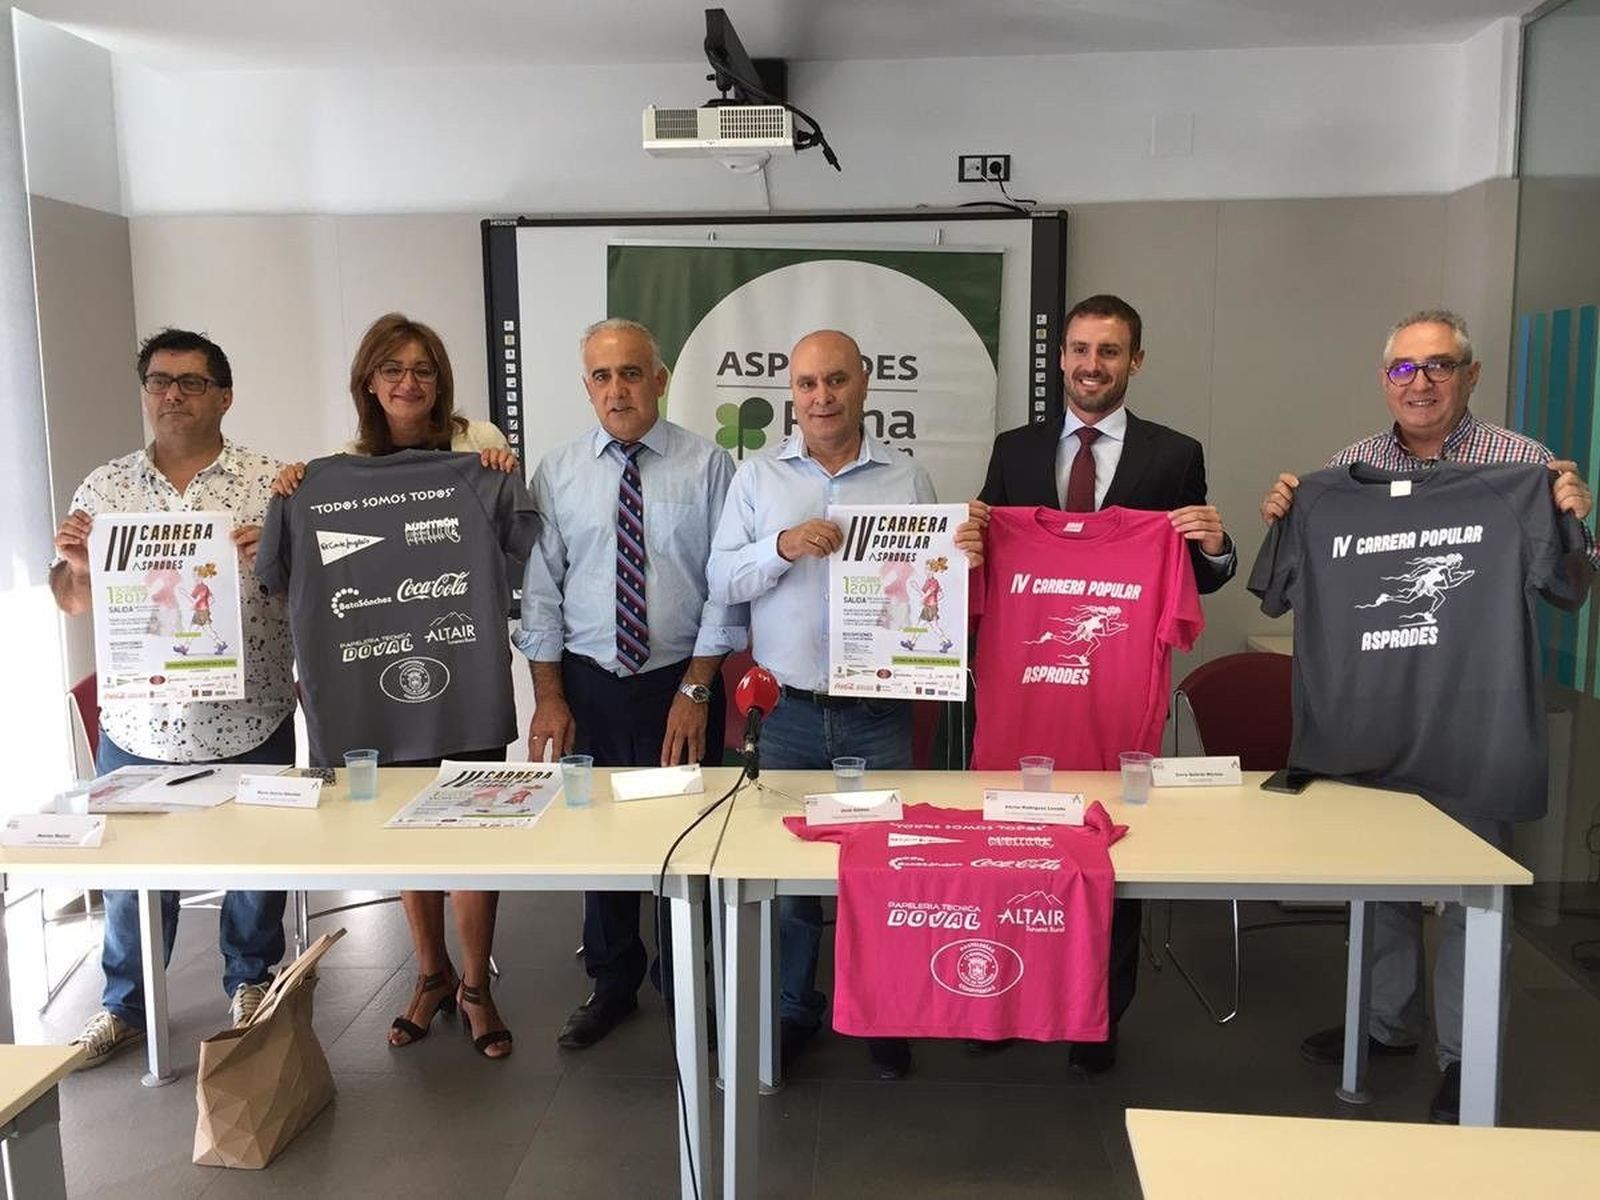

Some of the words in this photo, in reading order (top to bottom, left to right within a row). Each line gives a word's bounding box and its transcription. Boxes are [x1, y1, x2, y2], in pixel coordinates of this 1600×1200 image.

[362, 493, 406, 508] SOMOS
[104, 525, 137, 571] IV
[140, 523, 214, 541] CARRERA
[842, 516, 876, 561] IV
[878, 516, 948, 533] CARRERA
[872, 535, 931, 549] POPULAR
[1332, 535, 1353, 558] IV
[1356, 531, 1417, 555] CARRERA
[1420, 525, 1483, 548] POPULAR
[135, 543, 197, 557] POPULAR
[397, 571, 470, 602] Coca-Cola
[1010, 573, 1031, 594] IV
[1032, 578, 1085, 596] CARRERA
[1087, 581, 1142, 600] POPULAR
[424, 624, 476, 643] ALTAIR
[1361, 626, 1439, 651] ASPRODES
[342, 638, 414, 662] DOVAL
[1022, 666, 1090, 685] ASPRODES
[484, 771, 553, 779] CARRERA
[887, 910, 981, 931] DOVAL
[998, 908, 1065, 926] ALTAIR
